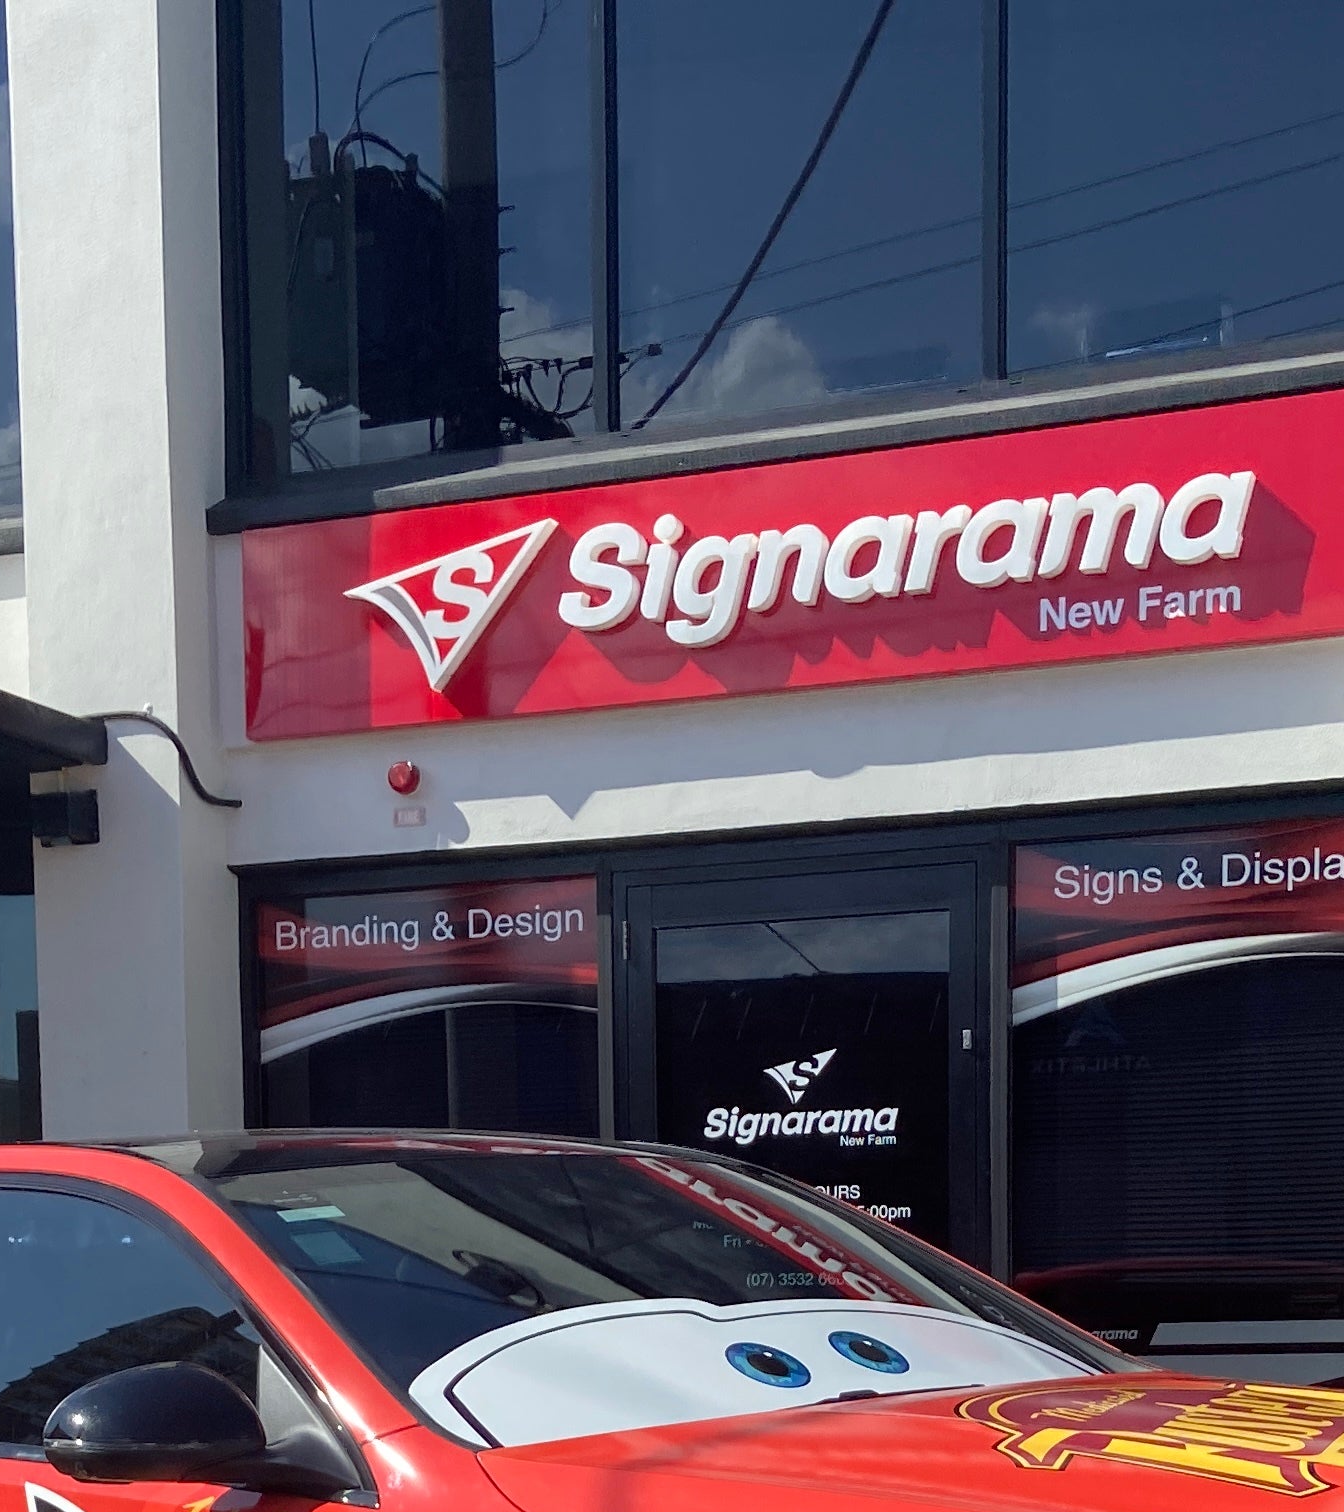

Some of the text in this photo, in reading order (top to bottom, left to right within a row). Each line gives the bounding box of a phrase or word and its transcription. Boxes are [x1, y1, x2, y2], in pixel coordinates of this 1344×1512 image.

[558, 469, 1258, 648] Signarama
[1038, 583, 1243, 632] New Farm
[1054, 865, 1163, 905] Signs
[1177, 856, 1206, 890] &
[275, 904, 584, 951] Branding & Design
[703, 1106, 899, 1145] Signarama
[839, 1134, 897, 1147] New Farm
[746, 1272, 775, 1288] (07)
[777, 1272, 815, 1286] 3532
